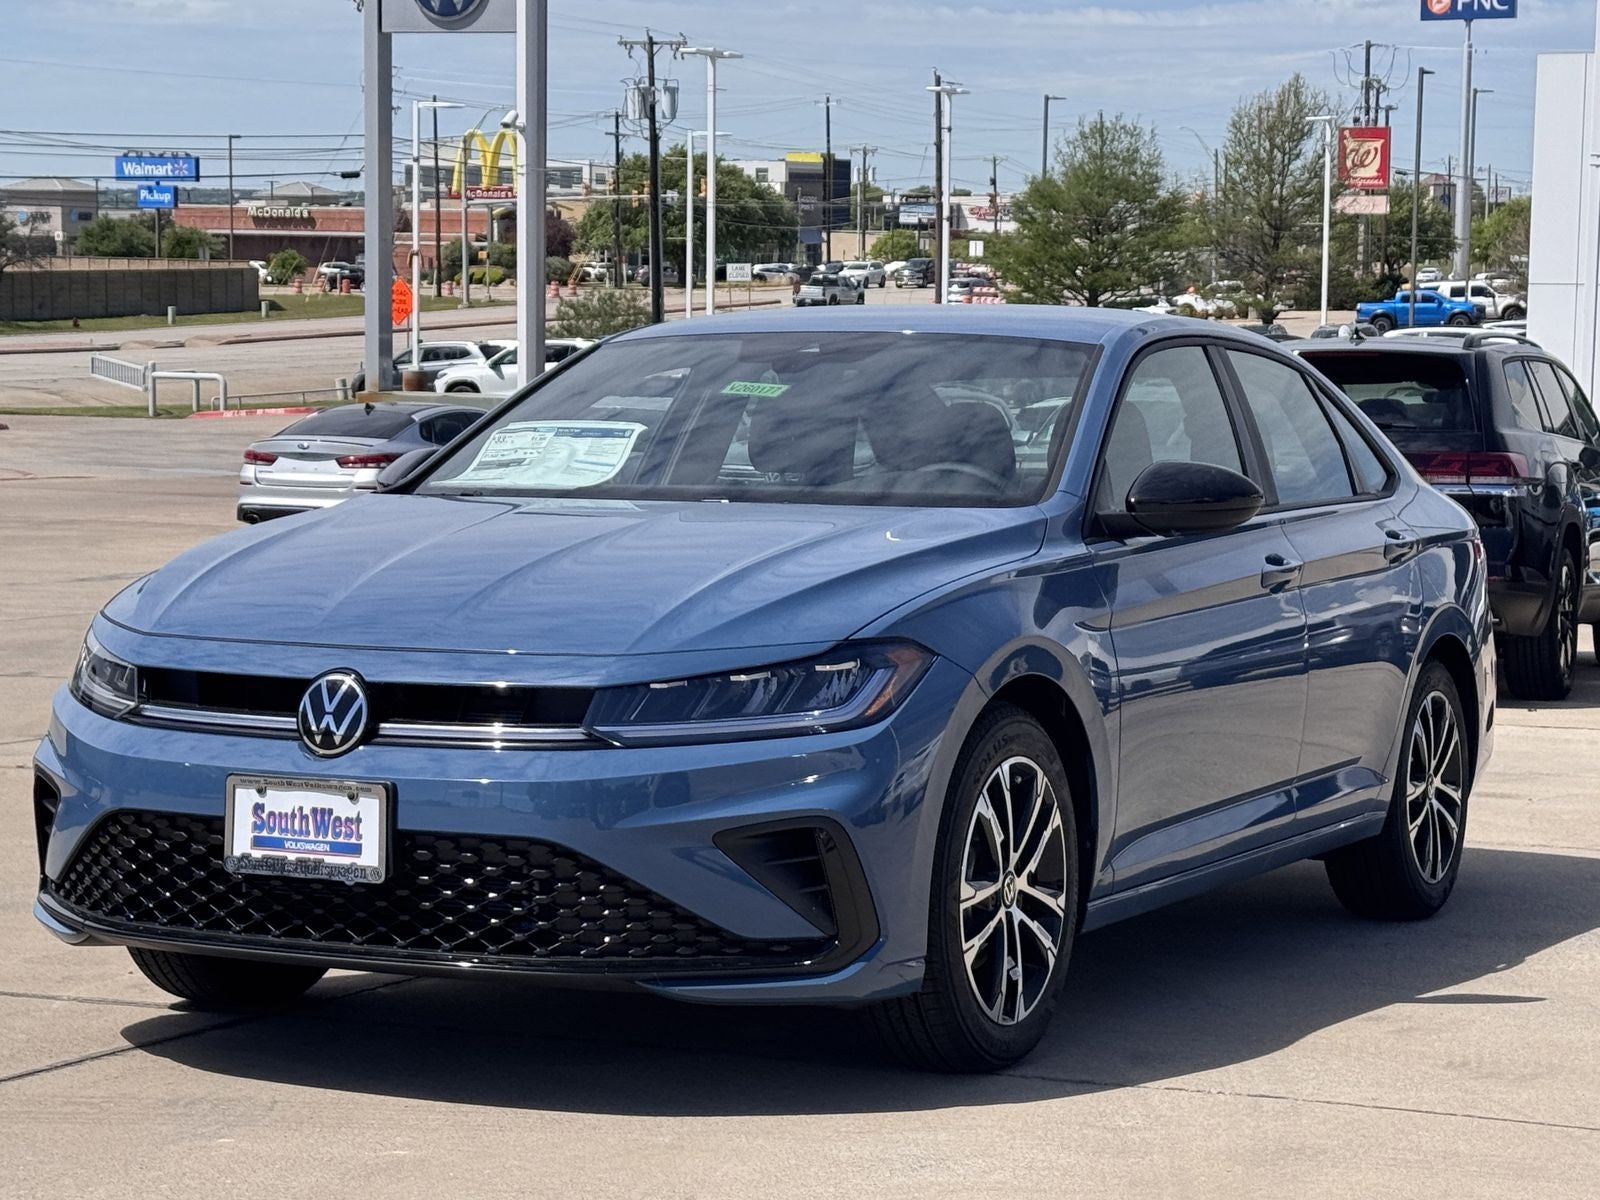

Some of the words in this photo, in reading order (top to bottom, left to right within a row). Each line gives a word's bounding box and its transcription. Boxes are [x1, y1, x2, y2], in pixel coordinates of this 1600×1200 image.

[122, 161, 173, 176] Walmart
[140, 189, 171, 203] Pickup
[251, 801, 363, 842] SouthWest
[284, 840, 331, 853] VOLKSWAGEN
